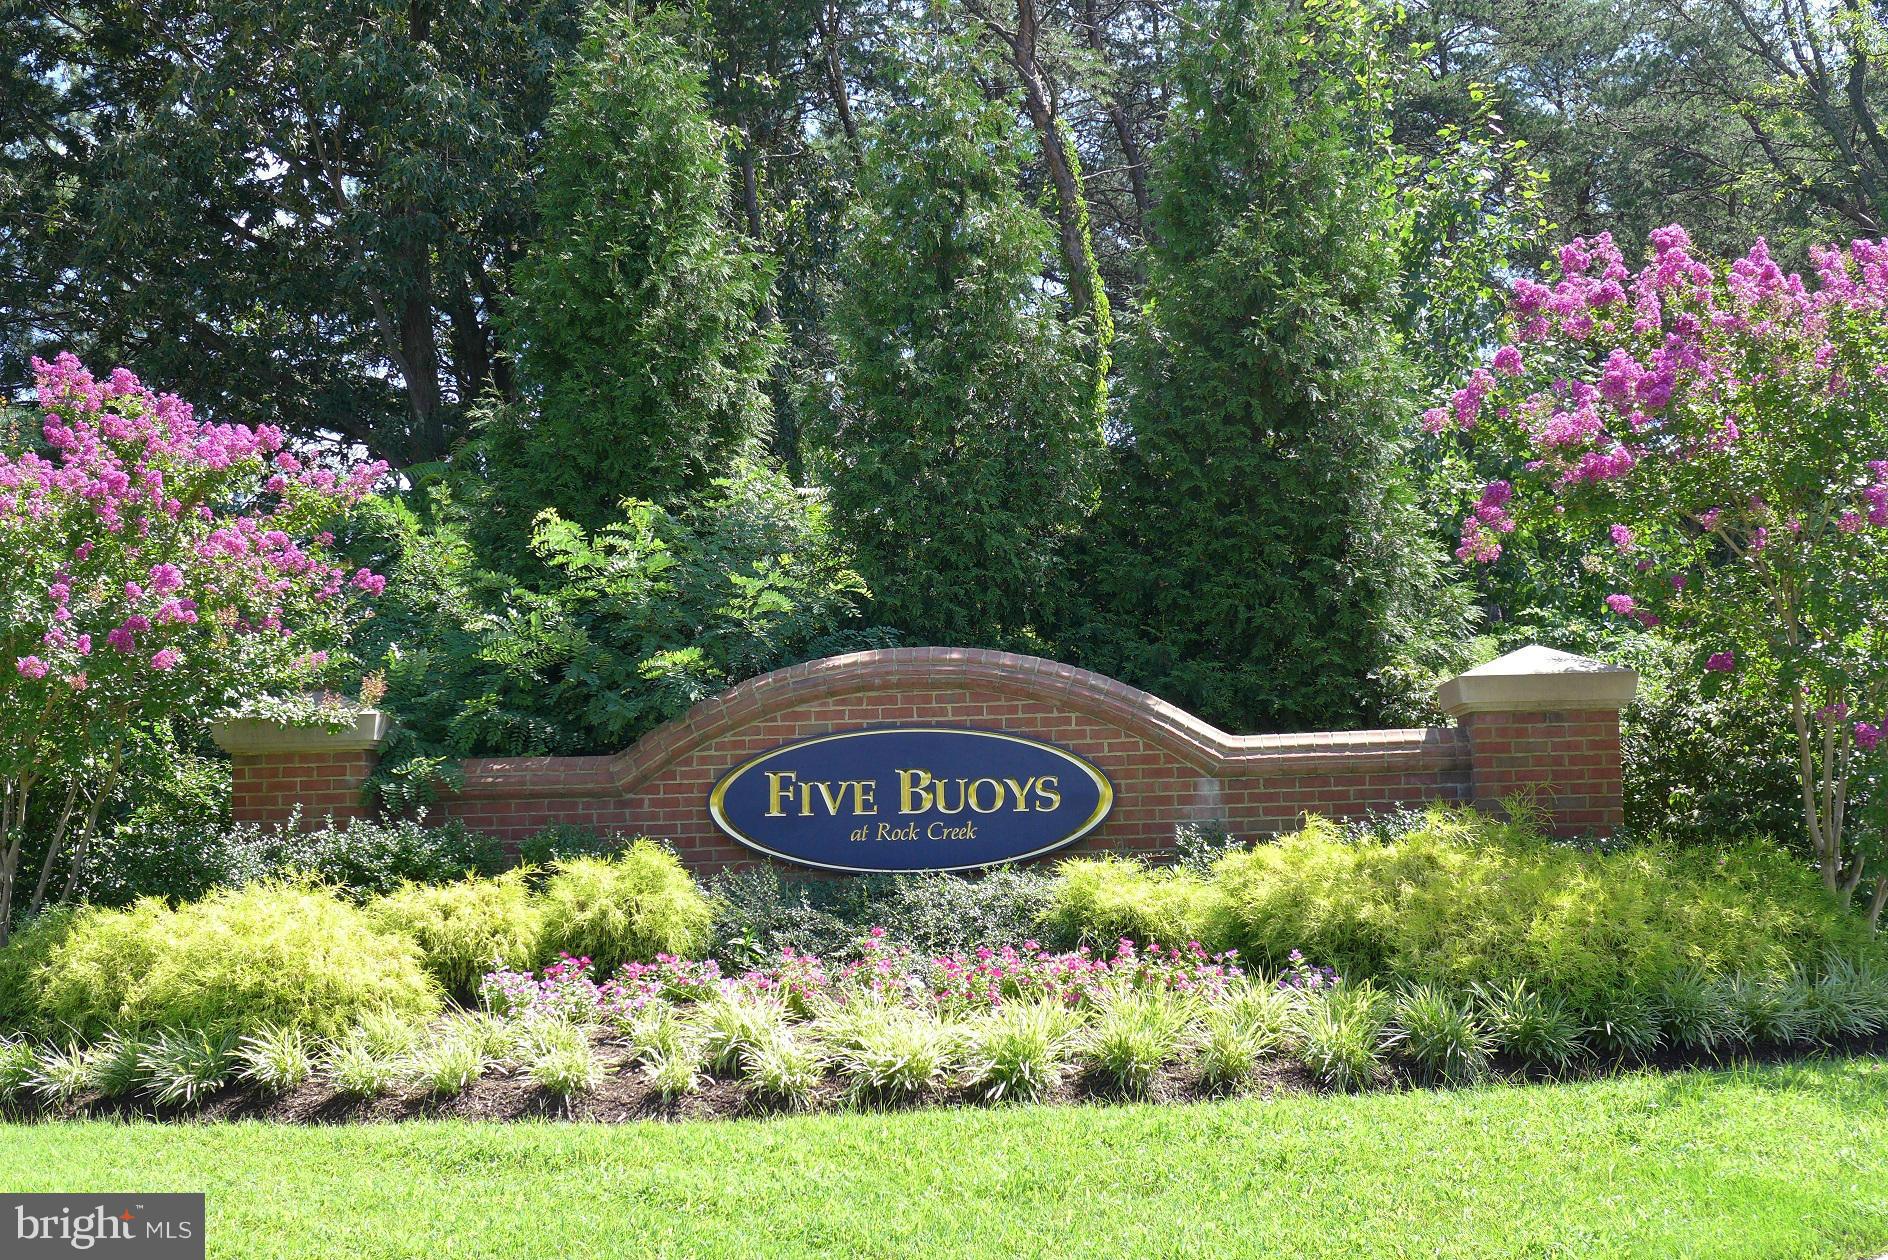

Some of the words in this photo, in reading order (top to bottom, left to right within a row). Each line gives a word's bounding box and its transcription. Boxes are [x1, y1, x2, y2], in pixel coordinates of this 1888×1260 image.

[764, 770, 877, 817] FIVE
[895, 768, 1062, 815] BUOYS
[850, 822, 869, 842] at
[876, 821, 920, 841] Rock
[927, 820, 978, 841] Creek
